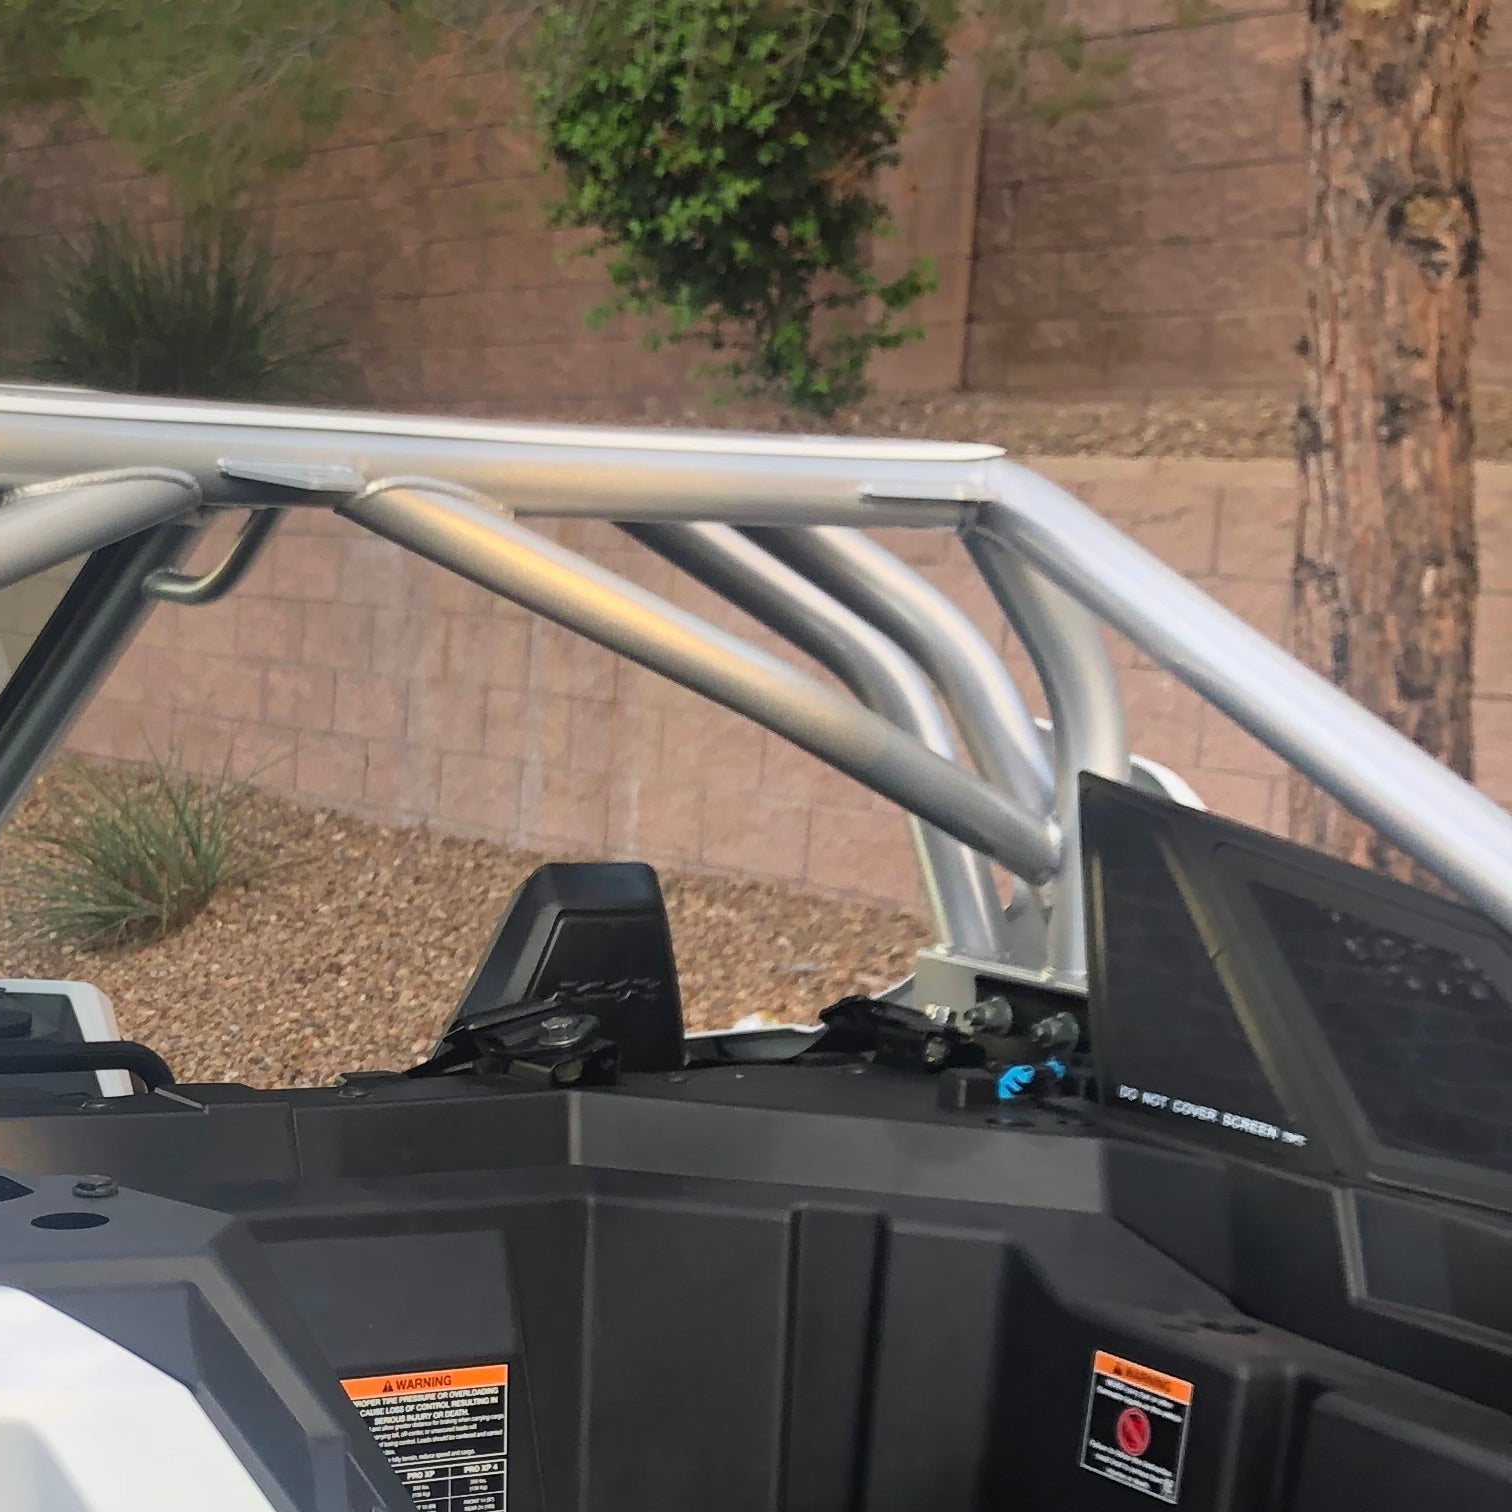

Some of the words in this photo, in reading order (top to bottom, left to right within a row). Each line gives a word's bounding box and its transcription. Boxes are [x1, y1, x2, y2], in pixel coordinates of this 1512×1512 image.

[1119, 1084, 1139, 1101] DO
[1142, 1091, 1170, 1109] NOT
[1172, 1100, 1219, 1122] COVER
[396, 1375, 452, 1391] WARNING
[437, 1391, 448, 1399] OR
[449, 1387, 499, 1398] OVERLOADING
[360, 1406, 385, 1417] CAUSE
[386, 1405, 404, 1415] LOSS
[405, 1404, 415, 1412] OF
[416, 1401, 450, 1412] CONTROL
[451, 1397, 489, 1408] RESULTING
[374, 1415, 405, 1426] SERIOUS
[406, 1412, 433, 1422] INJURY
[433, 1411, 444, 1419] OR
[407, 1471, 423, 1480] PRO
[424, 1470, 436, 1478] XP
[464, 1465, 480, 1473] PRO
[481, 1463, 492, 1472] XP
